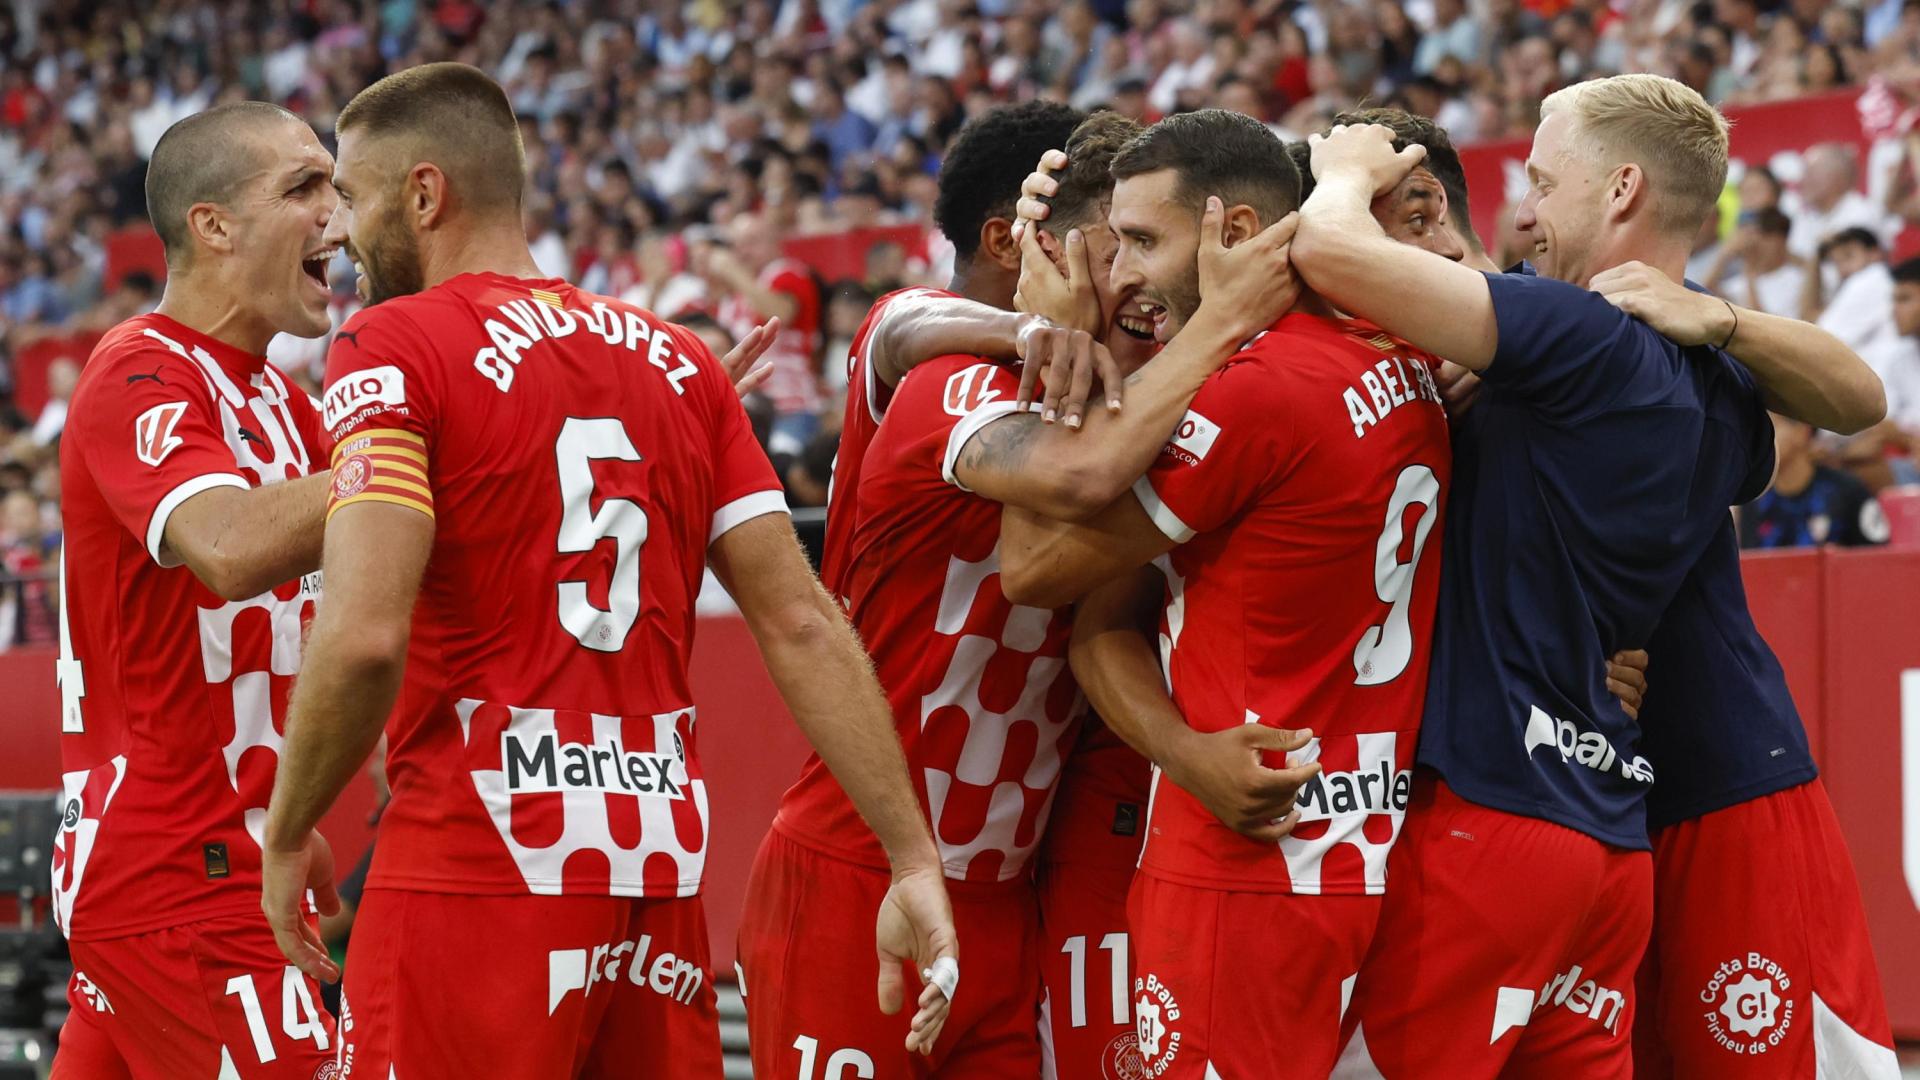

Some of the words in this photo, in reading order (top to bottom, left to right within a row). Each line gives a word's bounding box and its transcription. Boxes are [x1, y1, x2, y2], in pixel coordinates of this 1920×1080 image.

[474, 298, 577, 393] DAVID
[325, 378, 382, 422] HYLO
[1343, 357, 1416, 439] ABEL
[555, 416, 648, 653] 5
[1353, 464, 1440, 685] 9
[506, 734, 679, 795] Marlex
[1296, 761, 1412, 814] Marle
[1061, 933, 1130, 1027] 11
[1146, 974, 1181, 1021] Brava
[1700, 959, 1743, 1003] Costa
[1747, 952, 1790, 991] Brava
[225, 965, 330, 1063] 14
[1139, 1015, 1154, 1045] G!
[1704, 1012, 1745, 1054] Pirineu
[1749, 1041, 1767, 1055] de
[1768, 1000, 1793, 1046] Girona
[1736, 992, 1767, 1020] G!
[1113, 1035, 1138, 1050] GIRO
[1153, 1032, 1181, 1076] Girona
